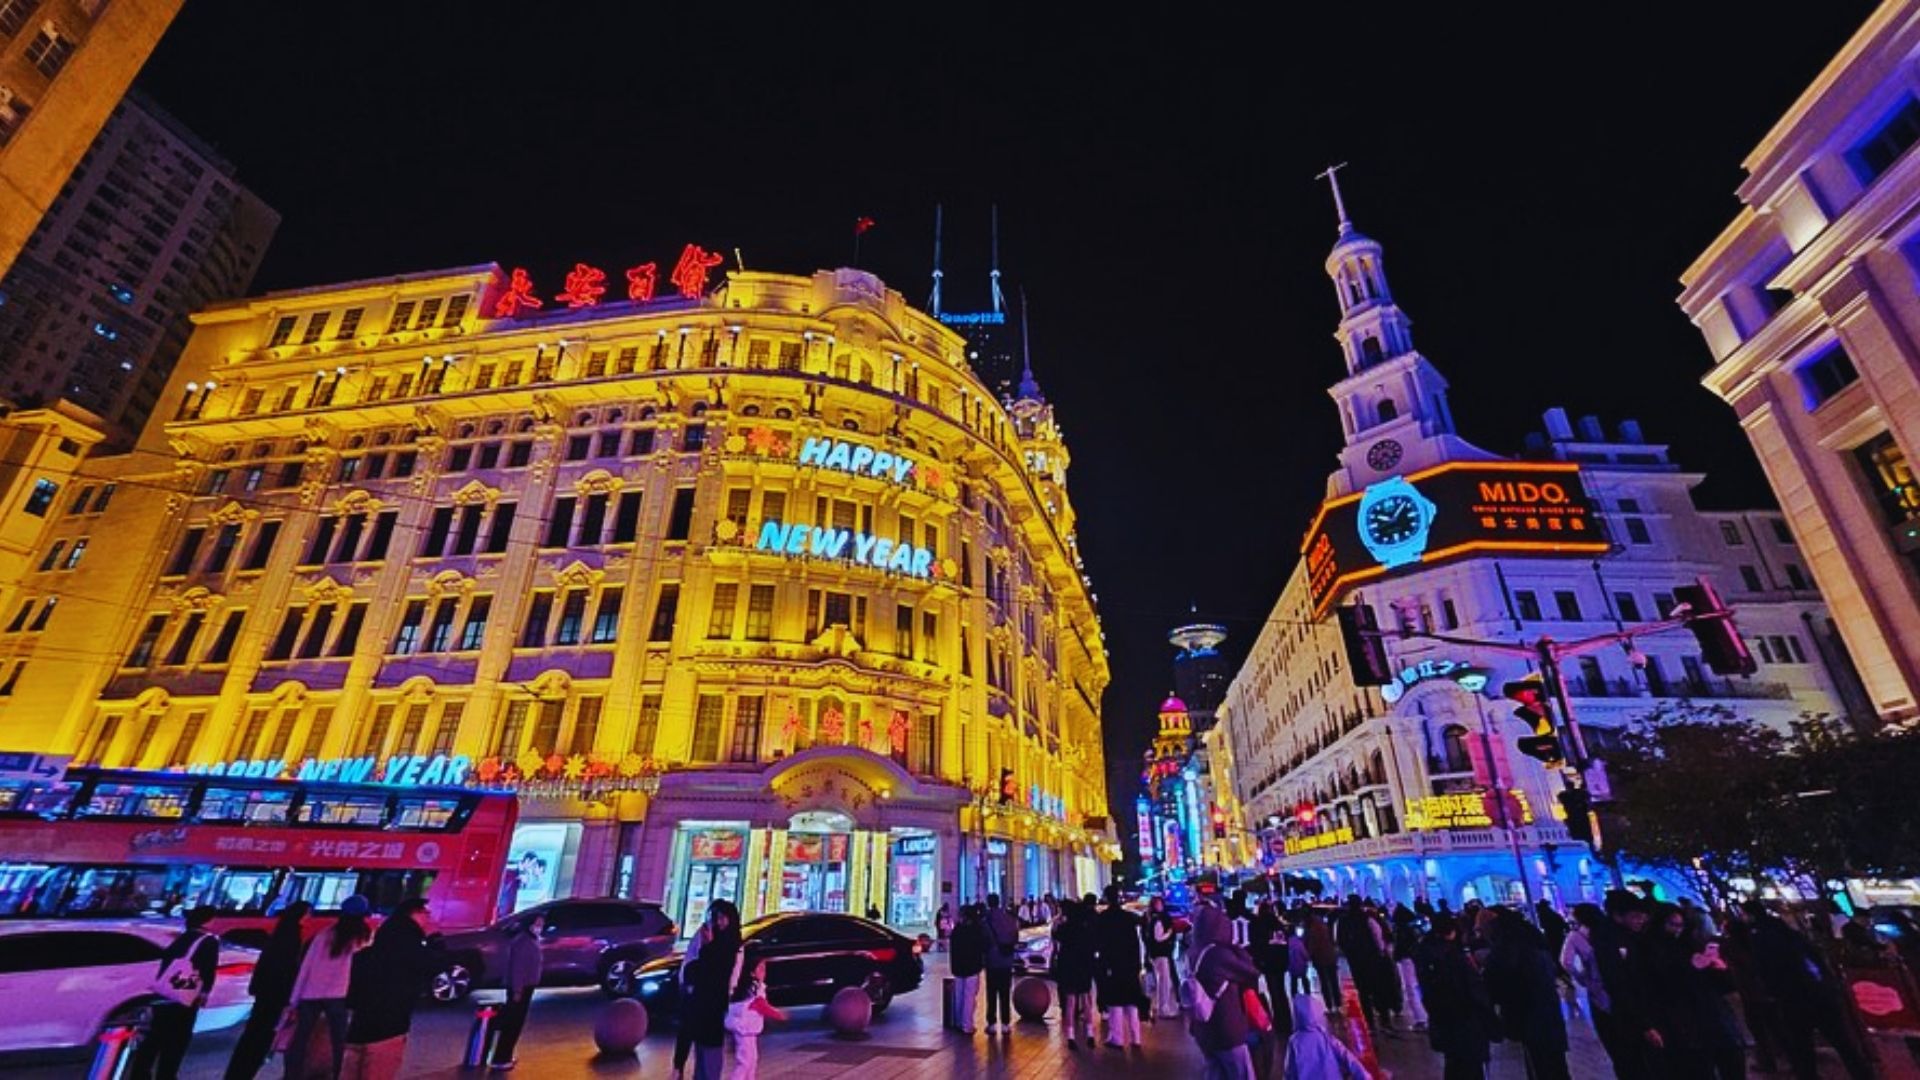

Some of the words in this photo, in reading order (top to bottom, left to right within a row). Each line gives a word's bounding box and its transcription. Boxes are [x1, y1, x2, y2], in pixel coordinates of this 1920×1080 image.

[800, 437, 912, 482] HAPPY
[757, 520, 849, 558] NEW
[853, 532, 932, 578] YEAR
[298, 757, 375, 782] NEW
[383, 755, 471, 785] YEAR
